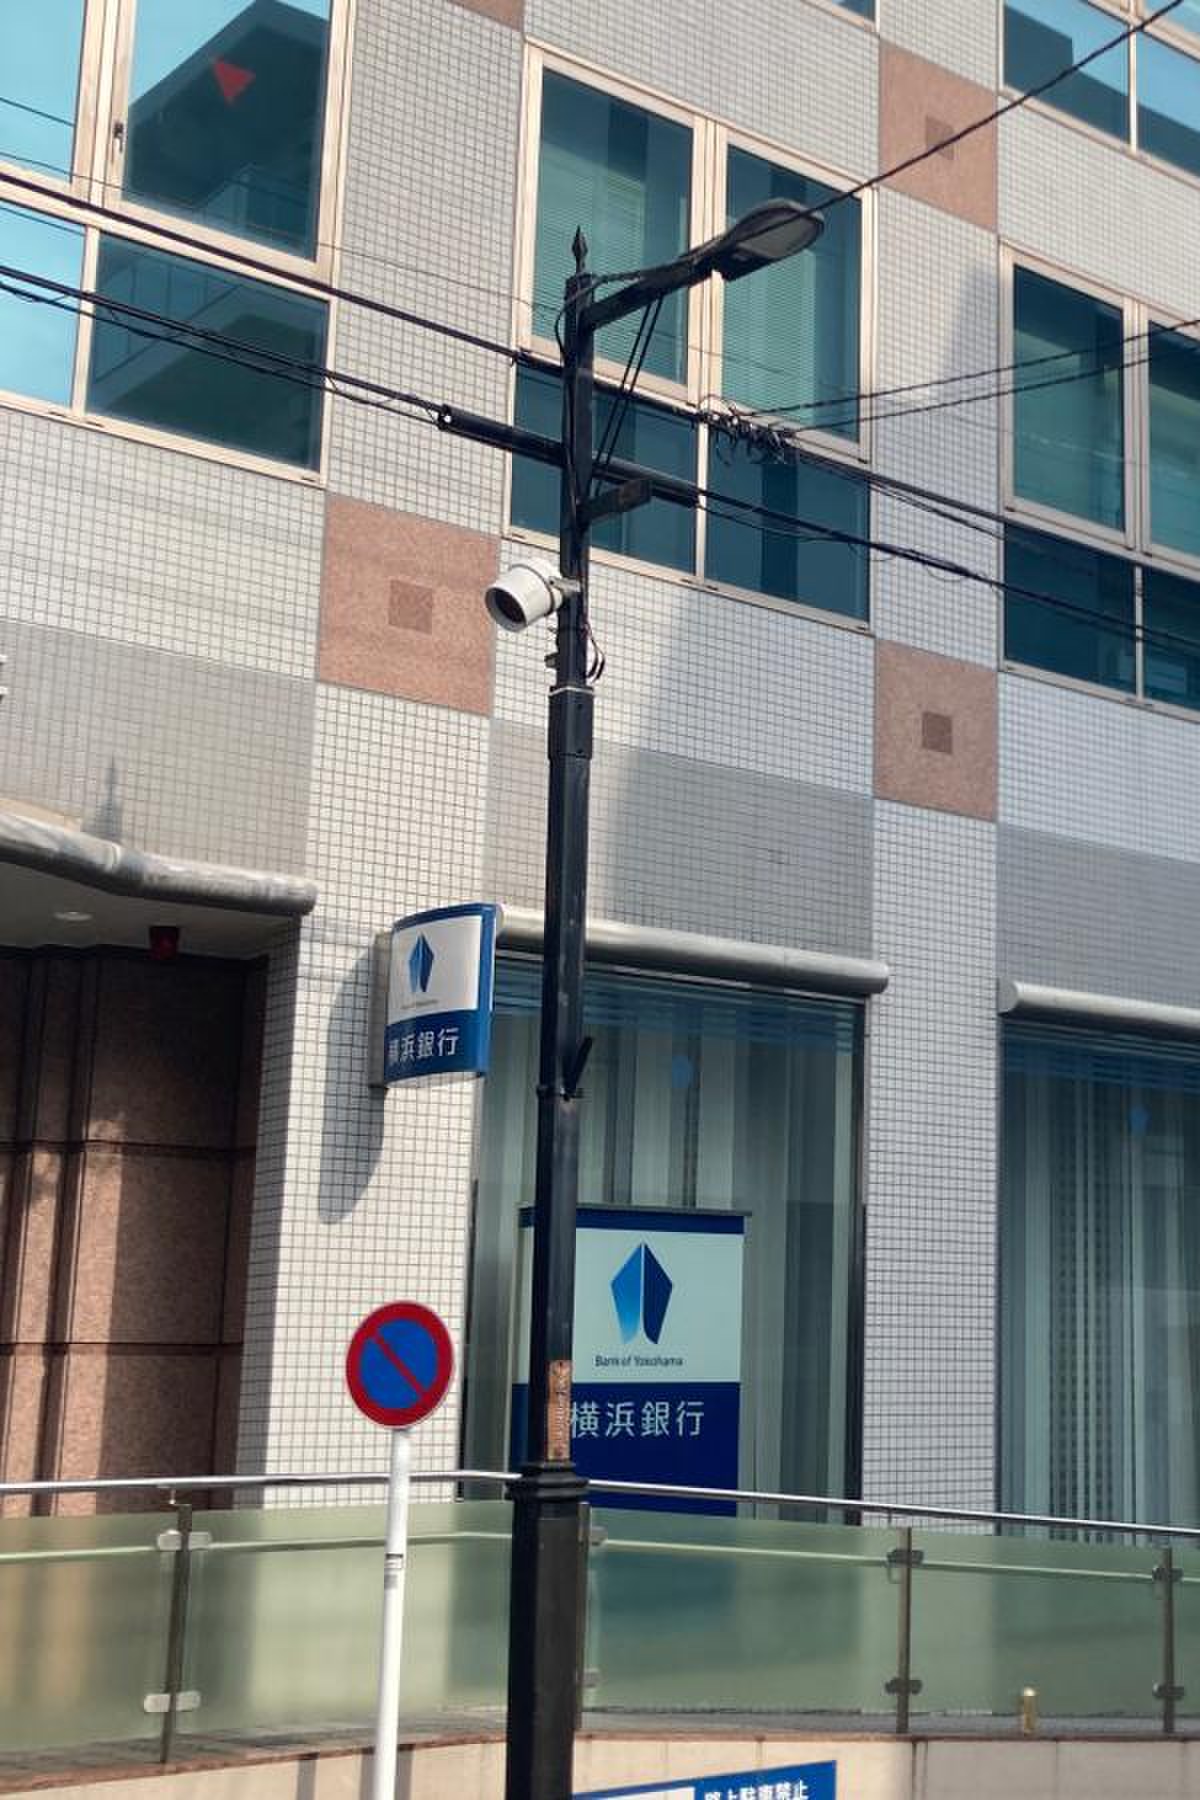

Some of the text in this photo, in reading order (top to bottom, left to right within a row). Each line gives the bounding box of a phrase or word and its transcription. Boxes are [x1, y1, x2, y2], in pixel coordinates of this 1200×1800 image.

[594, 1354, 684, 1368] Bank of Yokohama
[571, 1400, 705, 1438] 横浜銀行
